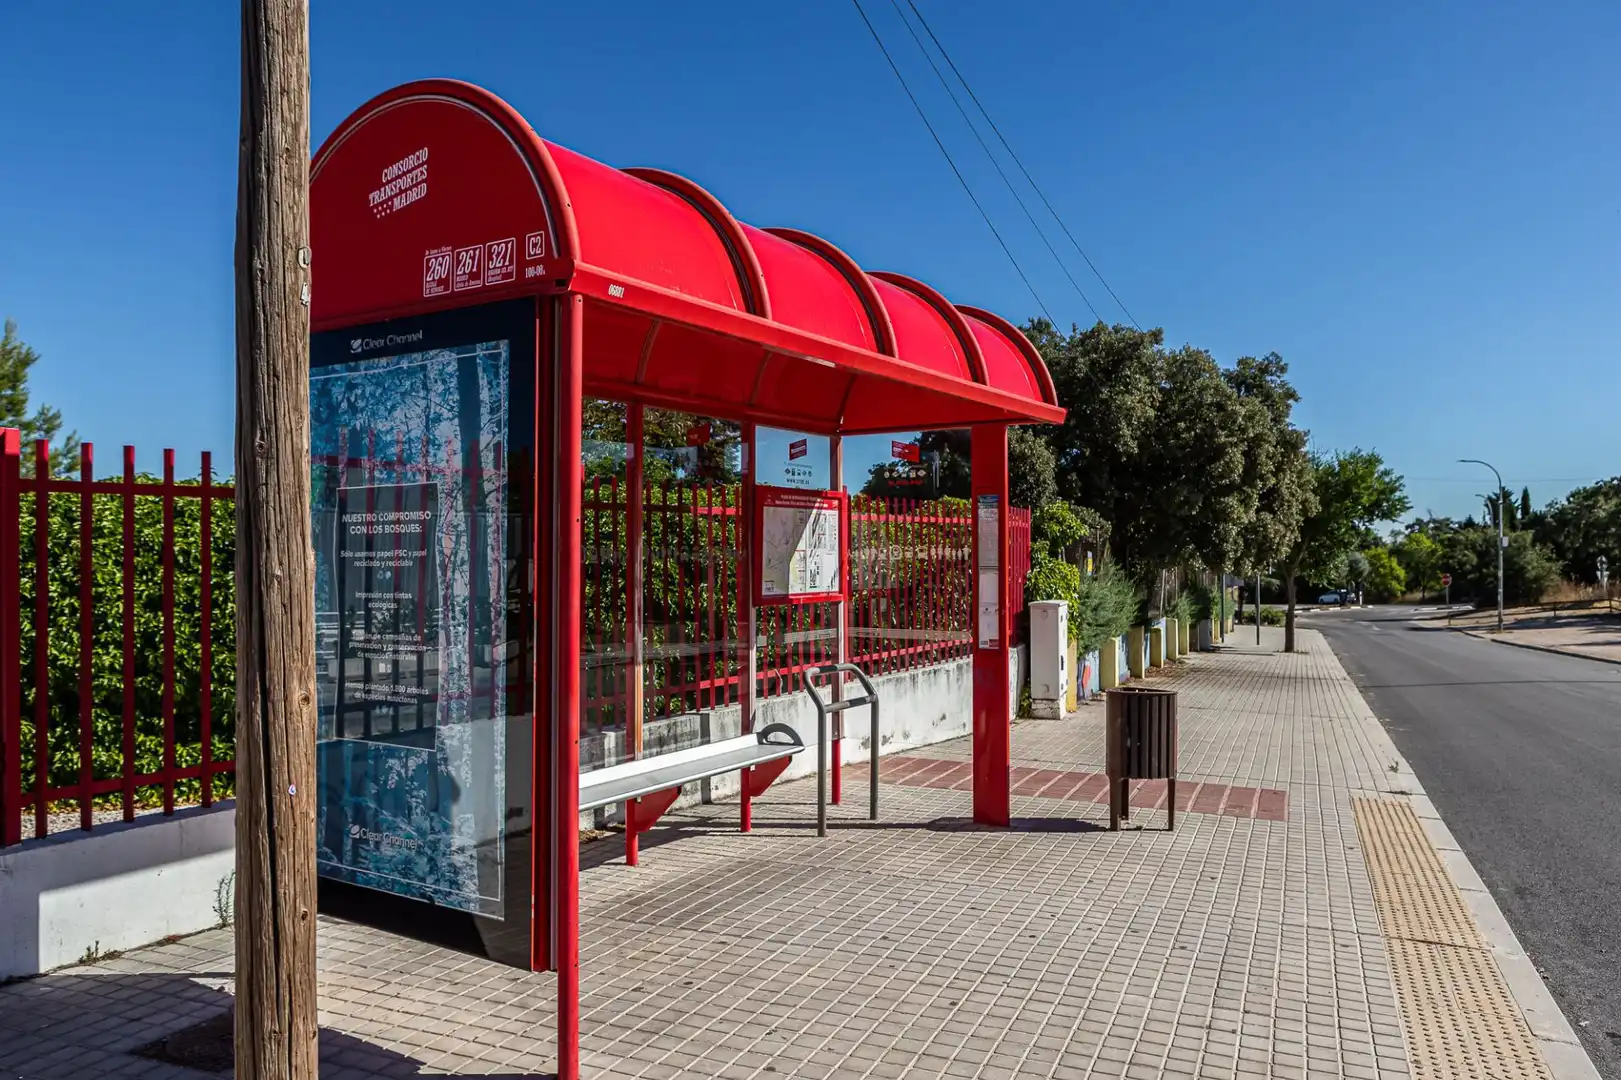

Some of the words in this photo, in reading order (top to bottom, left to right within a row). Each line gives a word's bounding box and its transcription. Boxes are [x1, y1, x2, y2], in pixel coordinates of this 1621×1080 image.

[382, 147, 428, 183] CONSORCIO
[369, 164, 427, 207] TRANSPORTES
[393, 183, 427, 212] MADRID
[489, 241, 512, 269] 321
[529, 236, 541, 255] C2
[426, 255, 449, 281] 260
[457, 248, 480, 274] 261
[363, 338, 385, 349] Clear
[386, 329, 423, 346] Channel
[341, 513, 376, 523] NUESTRO
[378, 510, 431, 521] COMPROMISO
[350, 526, 367, 534] CON
[368, 525, 382, 534] LOS
[384, 524, 423, 534] BOSQUES:
[353, 559, 380, 567] reciclado
[385, 559, 413, 567] reciclable
[376, 550, 393, 560] papel
[394, 549, 407, 557] FSC
[412, 549, 427, 559] papel
[394, 591, 412, 599] tintas
[361, 827, 381, 841] Clear
[383, 831, 418, 849] Channel
